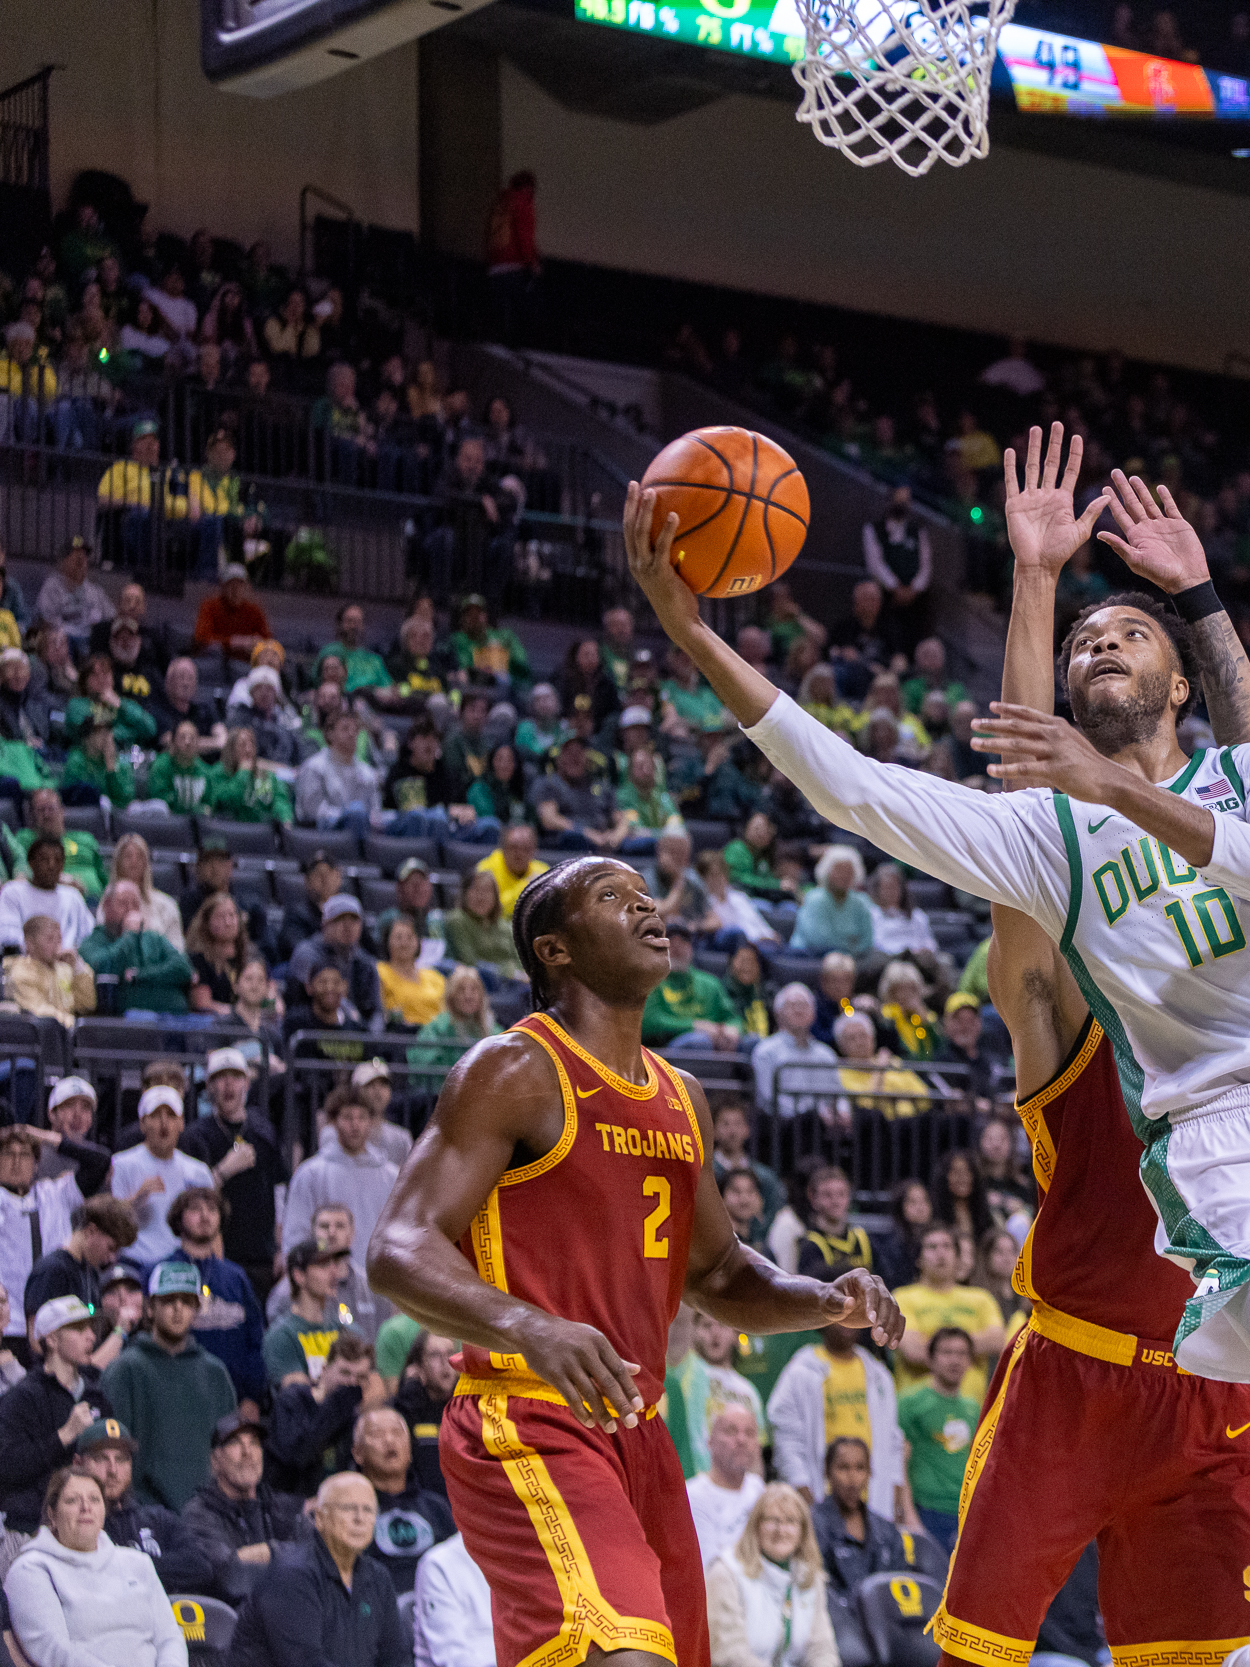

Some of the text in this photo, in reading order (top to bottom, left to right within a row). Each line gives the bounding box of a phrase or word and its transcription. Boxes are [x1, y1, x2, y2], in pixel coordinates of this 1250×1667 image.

[1091, 835, 1208, 928] DUC
[1164, 887, 1247, 968] 10
[595, 1122, 695, 1163] TROJANS
[642, 1175, 671, 1258] 2
[1141, 1348, 1175, 1367] USC
